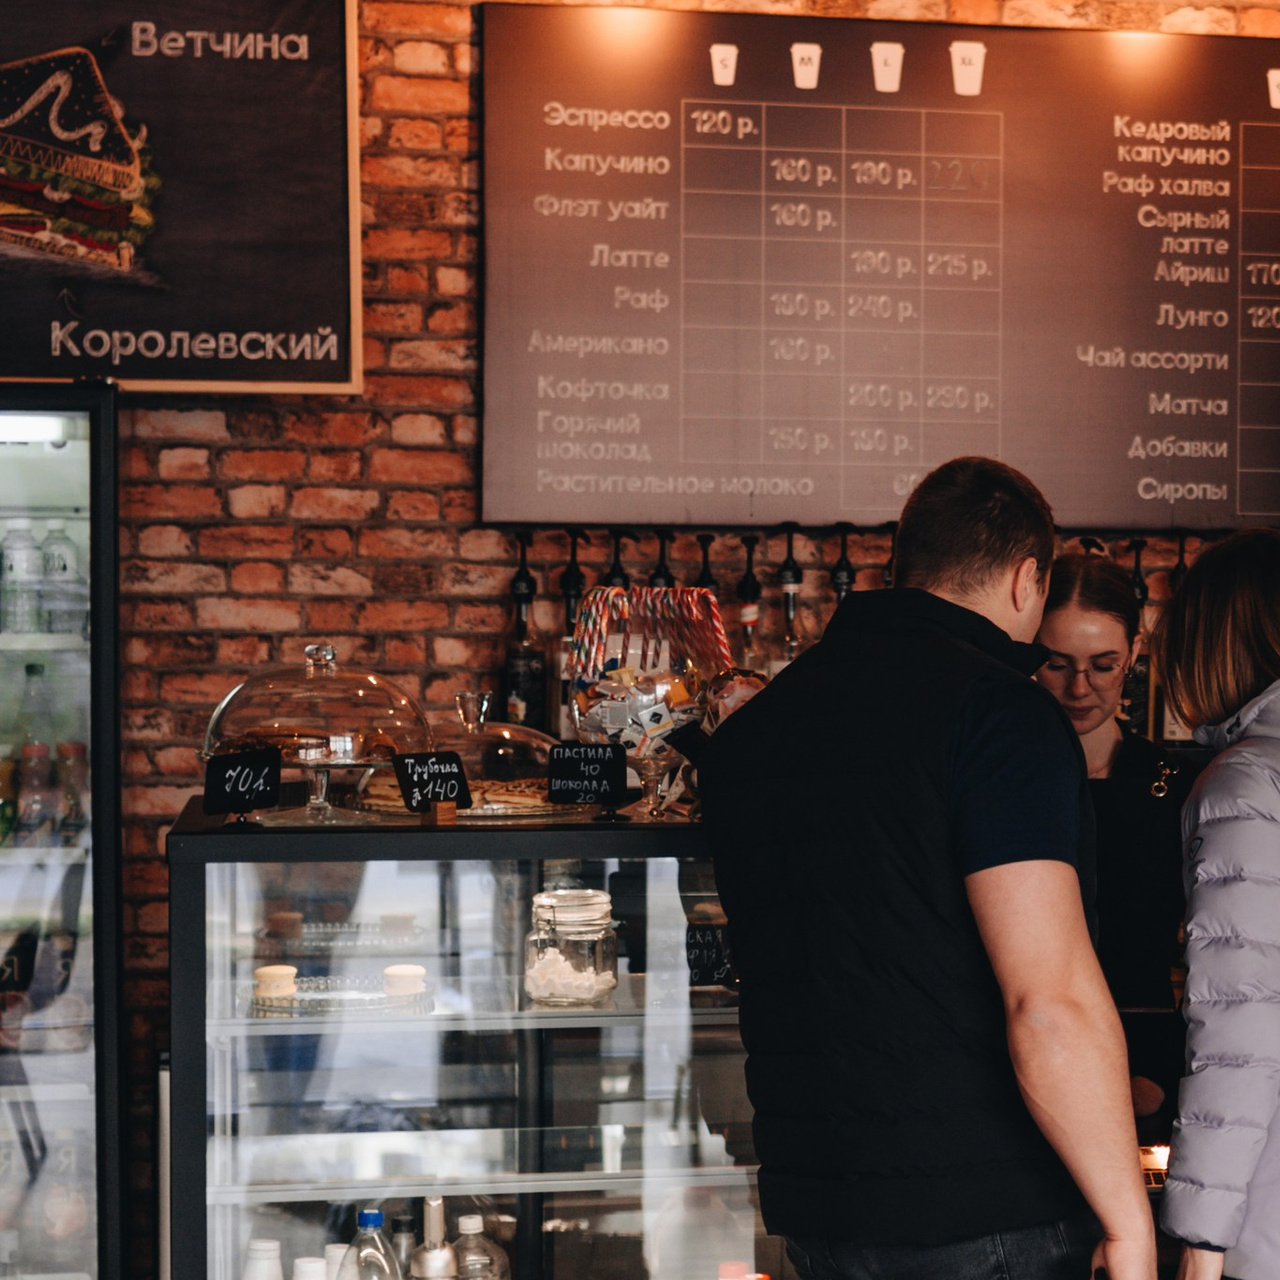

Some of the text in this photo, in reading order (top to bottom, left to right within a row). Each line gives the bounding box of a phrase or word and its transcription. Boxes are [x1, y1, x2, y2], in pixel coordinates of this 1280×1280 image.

[131, 21, 310, 61] Ветчина
[718, 55, 730, 70] S
[798, 55, 814, 68] M
[882, 56, 892, 69] L
[543, 100, 671, 132] Эспрессо
[690, 109, 733, 134] 120
[1113, 116, 1231, 147] Кедровый
[544, 146, 671, 177] Капучино
[1117, 141, 1230, 169] капучино
[1102, 171, 1154, 197] Раф
[1160, 176, 1230, 198] халва
[533, 193, 602, 217] Флэт
[607, 196, 671, 222] уайт
[1138, 205, 1229, 231] Сырный
[1160, 234, 1229, 256] латте
[589, 243, 671, 269] Латте
[926, 252, 968, 277] 215
[1154, 261, 1229, 287] Айриш
[614, 285, 670, 314] Раф
[1156, 304, 1229, 329] Лунго
[51, 320, 339, 365] Королевский
[527, 328, 671, 358] Американо
[1077, 345, 1126, 369] Чай
[1131, 350, 1228, 374] ассорти
[537, 375, 671, 403] Кофточка
[1148, 393, 1228, 417] Матча
[537, 410, 641, 438] Горячий
[537, 440, 652, 463] шоколад
[1128, 435, 1228, 461] Добавки
[537, 468, 715, 495] Растительное
[720, 475, 815, 496] молоко
[1138, 477, 1227, 502] Сиропы
[553, 747, 614, 760] ПАСТИЛА
[404, 757, 459, 781] Трубочка
[580, 761, 600, 776] 40
[576, 792, 596, 803] 20
